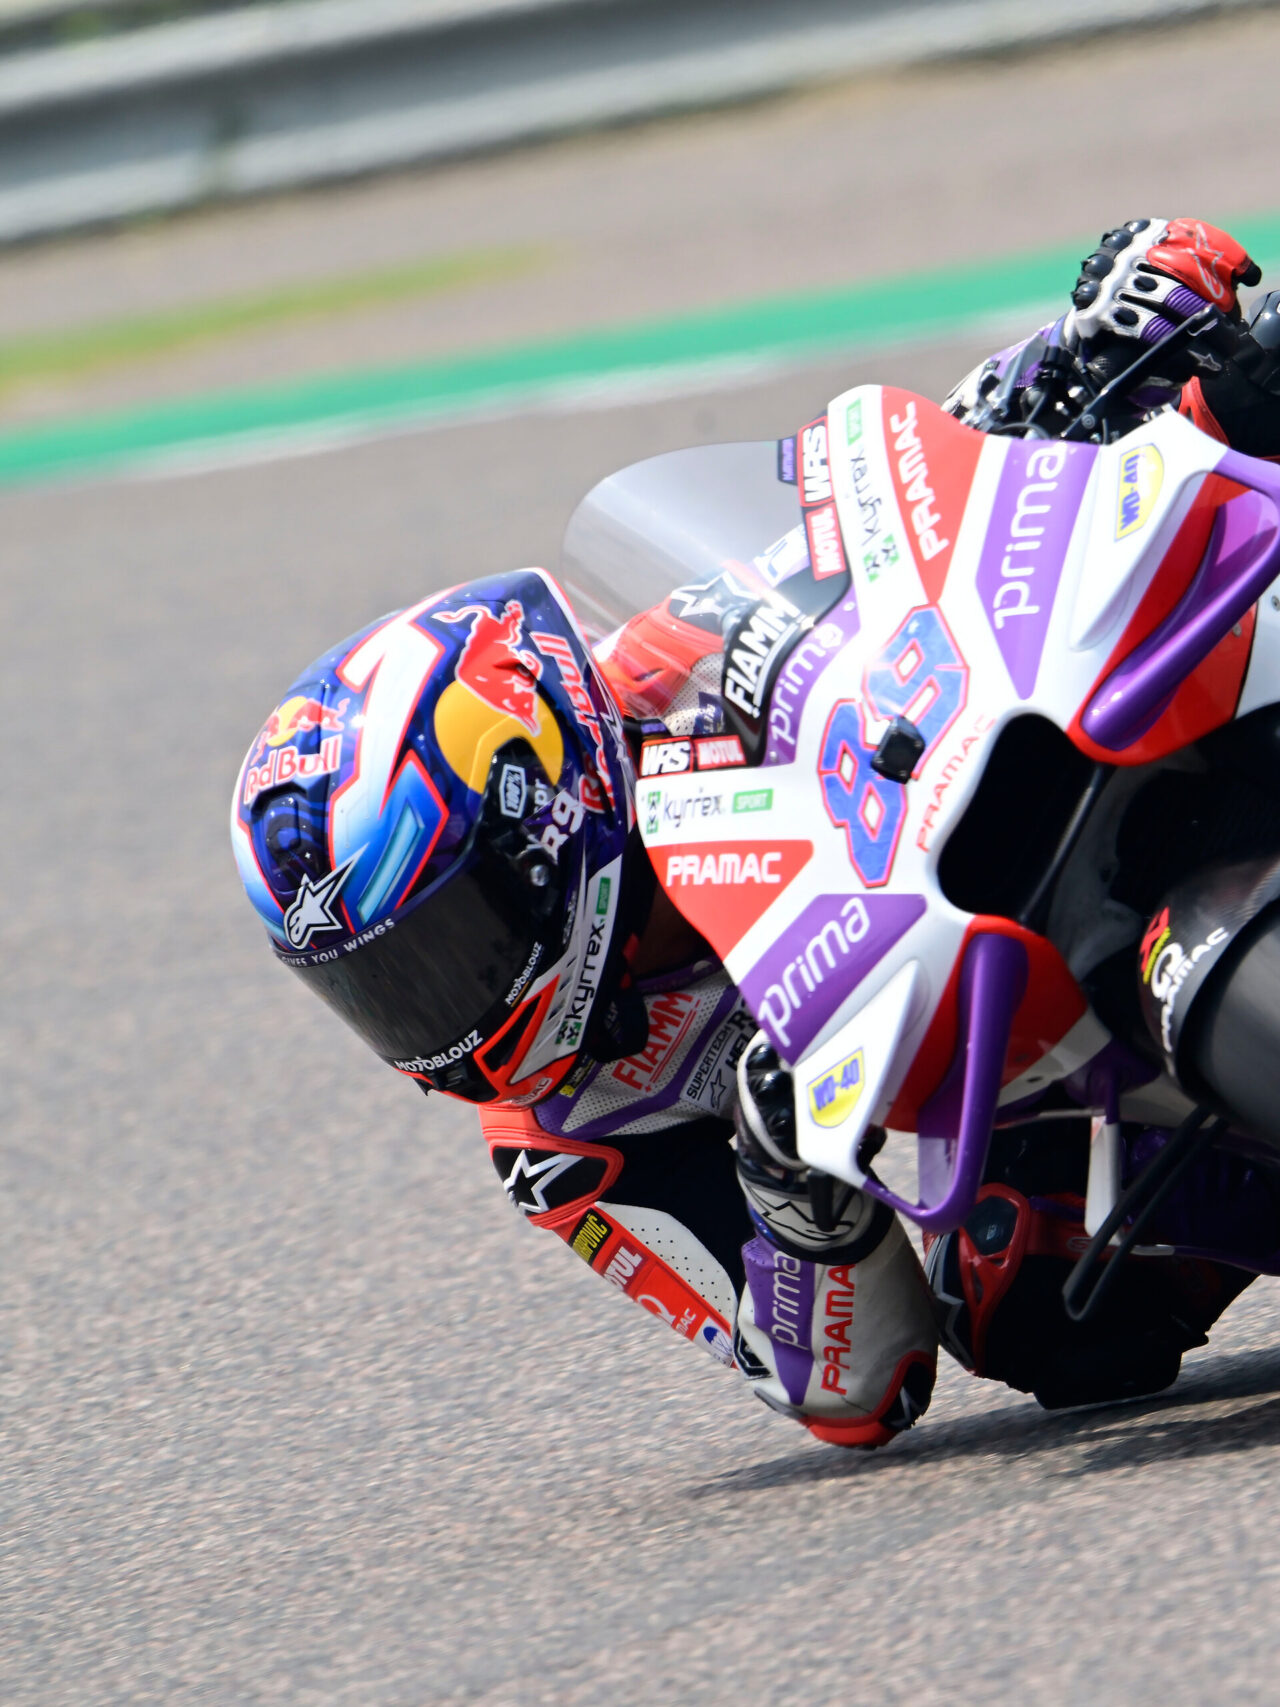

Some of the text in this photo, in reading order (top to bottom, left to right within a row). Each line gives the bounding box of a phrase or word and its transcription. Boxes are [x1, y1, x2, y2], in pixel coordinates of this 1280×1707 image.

[802, 424, 833, 503] WRS
[890, 400, 950, 562] PRAMAC
[810, 507, 843, 573] MOTUL
[993, 440, 1068, 630] prima
[529, 631, 597, 717] Bull
[724, 591, 801, 711] FIAMM
[770, 623, 844, 745] prima
[275, 734, 343, 784] Bull
[641, 739, 691, 776] WRS
[698, 738, 745, 766] MOTUL
[916, 713, 997, 853] PRAMAC
[662, 791, 722, 828] kyrrex
[666, 851, 782, 887] PRAMAC
[311, 948, 338, 964] YOU
[343, 917, 396, 953] WINGS
[505, 941, 543, 1006] MOTOBLOUZ
[565, 923, 605, 1021] kyrrex
[758, 896, 871, 1048] prima
[395, 1029, 484, 1073] MOTOBLOUZ
[611, 991, 694, 1091] FIAMM
[686, 1025, 732, 1100] SUPERTECH
[812, 1057, 860, 1112] WD-40
[604, 1246, 643, 1291] OTUL
[771, 1250, 809, 1351] prima
[820, 1263, 857, 1396] PRAMA
